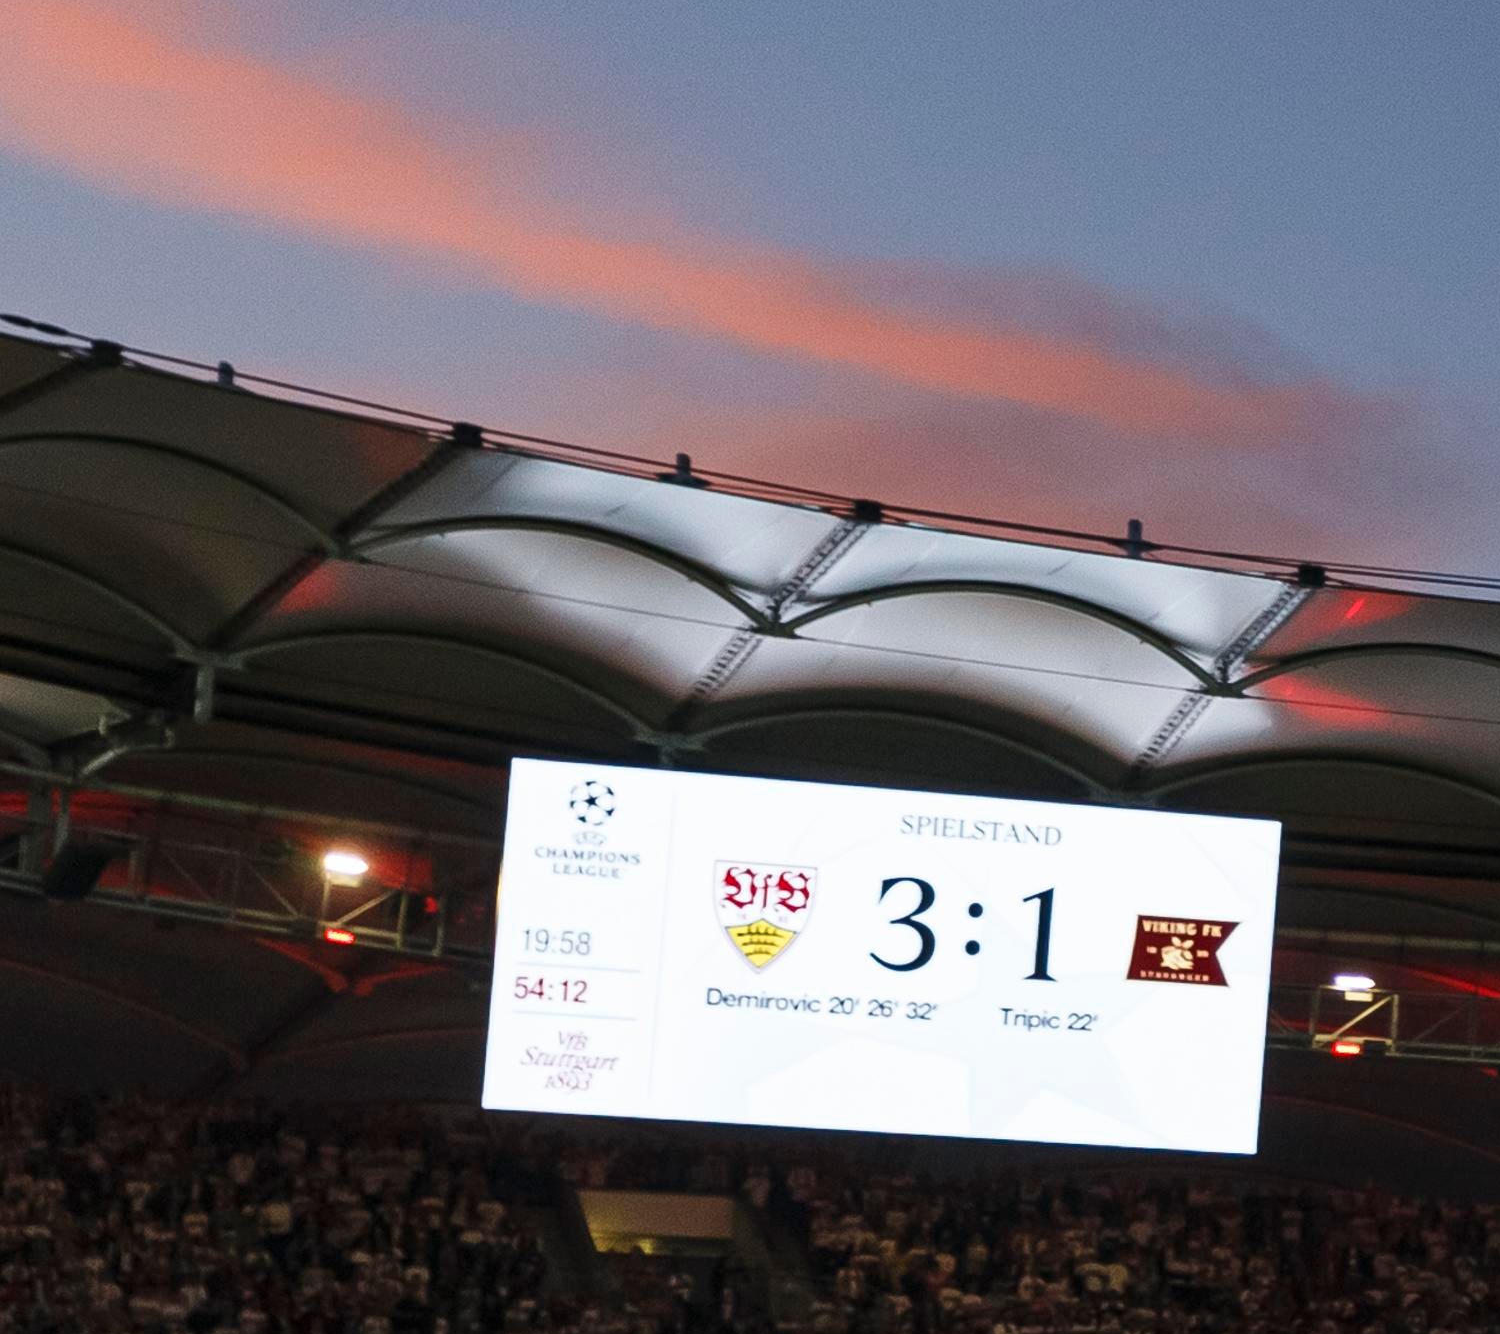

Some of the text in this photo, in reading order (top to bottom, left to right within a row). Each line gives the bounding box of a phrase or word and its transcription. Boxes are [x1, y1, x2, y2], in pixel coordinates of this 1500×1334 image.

[899, 814, 1063, 846] SPIELSTAND
[534, 846, 641, 865] CHAMPIONS
[552, 863, 622, 879] LEAGUE
[1142, 919, 1222, 937] VIKING FK
[523, 928, 591, 956] 19:58
[514, 976, 588, 1003] 54:12
[706, 987, 821, 1014] Demirovic
[1000, 1007, 1061, 1032] Tripic
